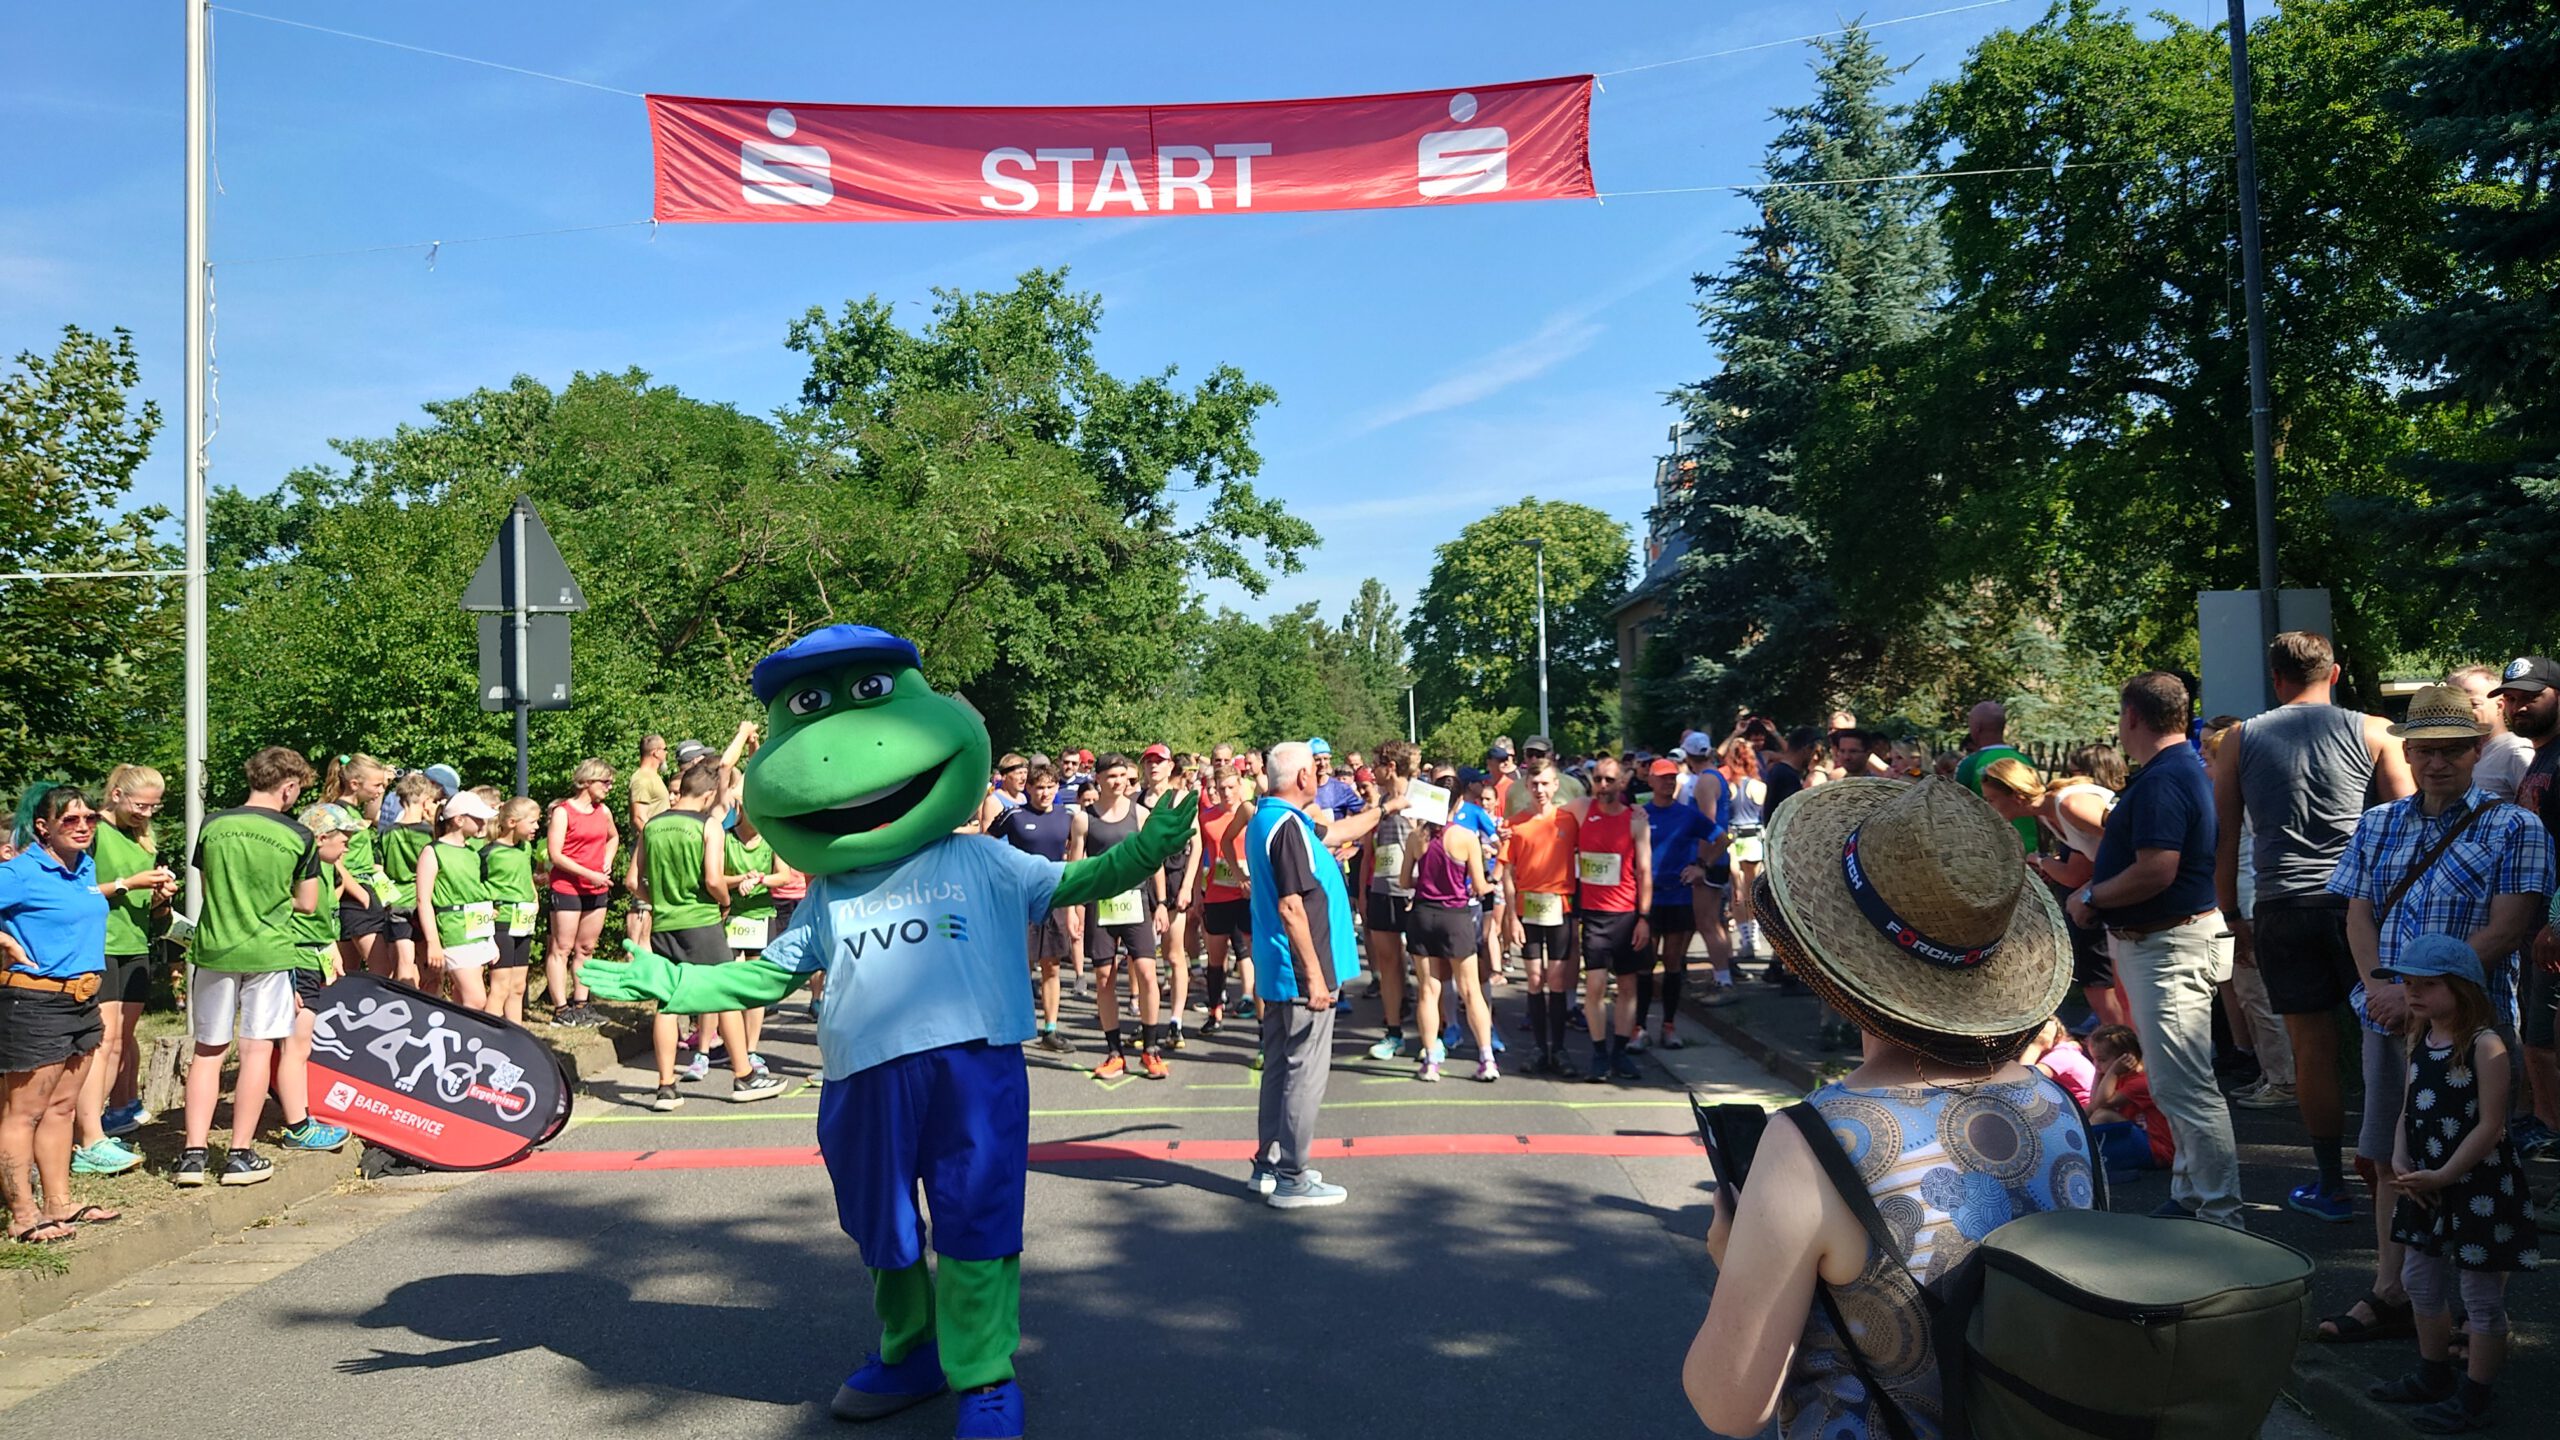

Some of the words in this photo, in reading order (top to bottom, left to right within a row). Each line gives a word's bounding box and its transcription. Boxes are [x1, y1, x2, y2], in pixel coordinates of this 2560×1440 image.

[979, 142, 1273, 214] START
[220, 830, 287, 854] SCHARFENBERG
[837, 878, 968, 921] Mobilius
[1109, 902, 1132, 913] 1100
[842, 917, 930, 960] VVO
[353, 1094, 446, 1136] BAER-SERVICE
[469, 1085, 521, 1110] Ergebnisse
